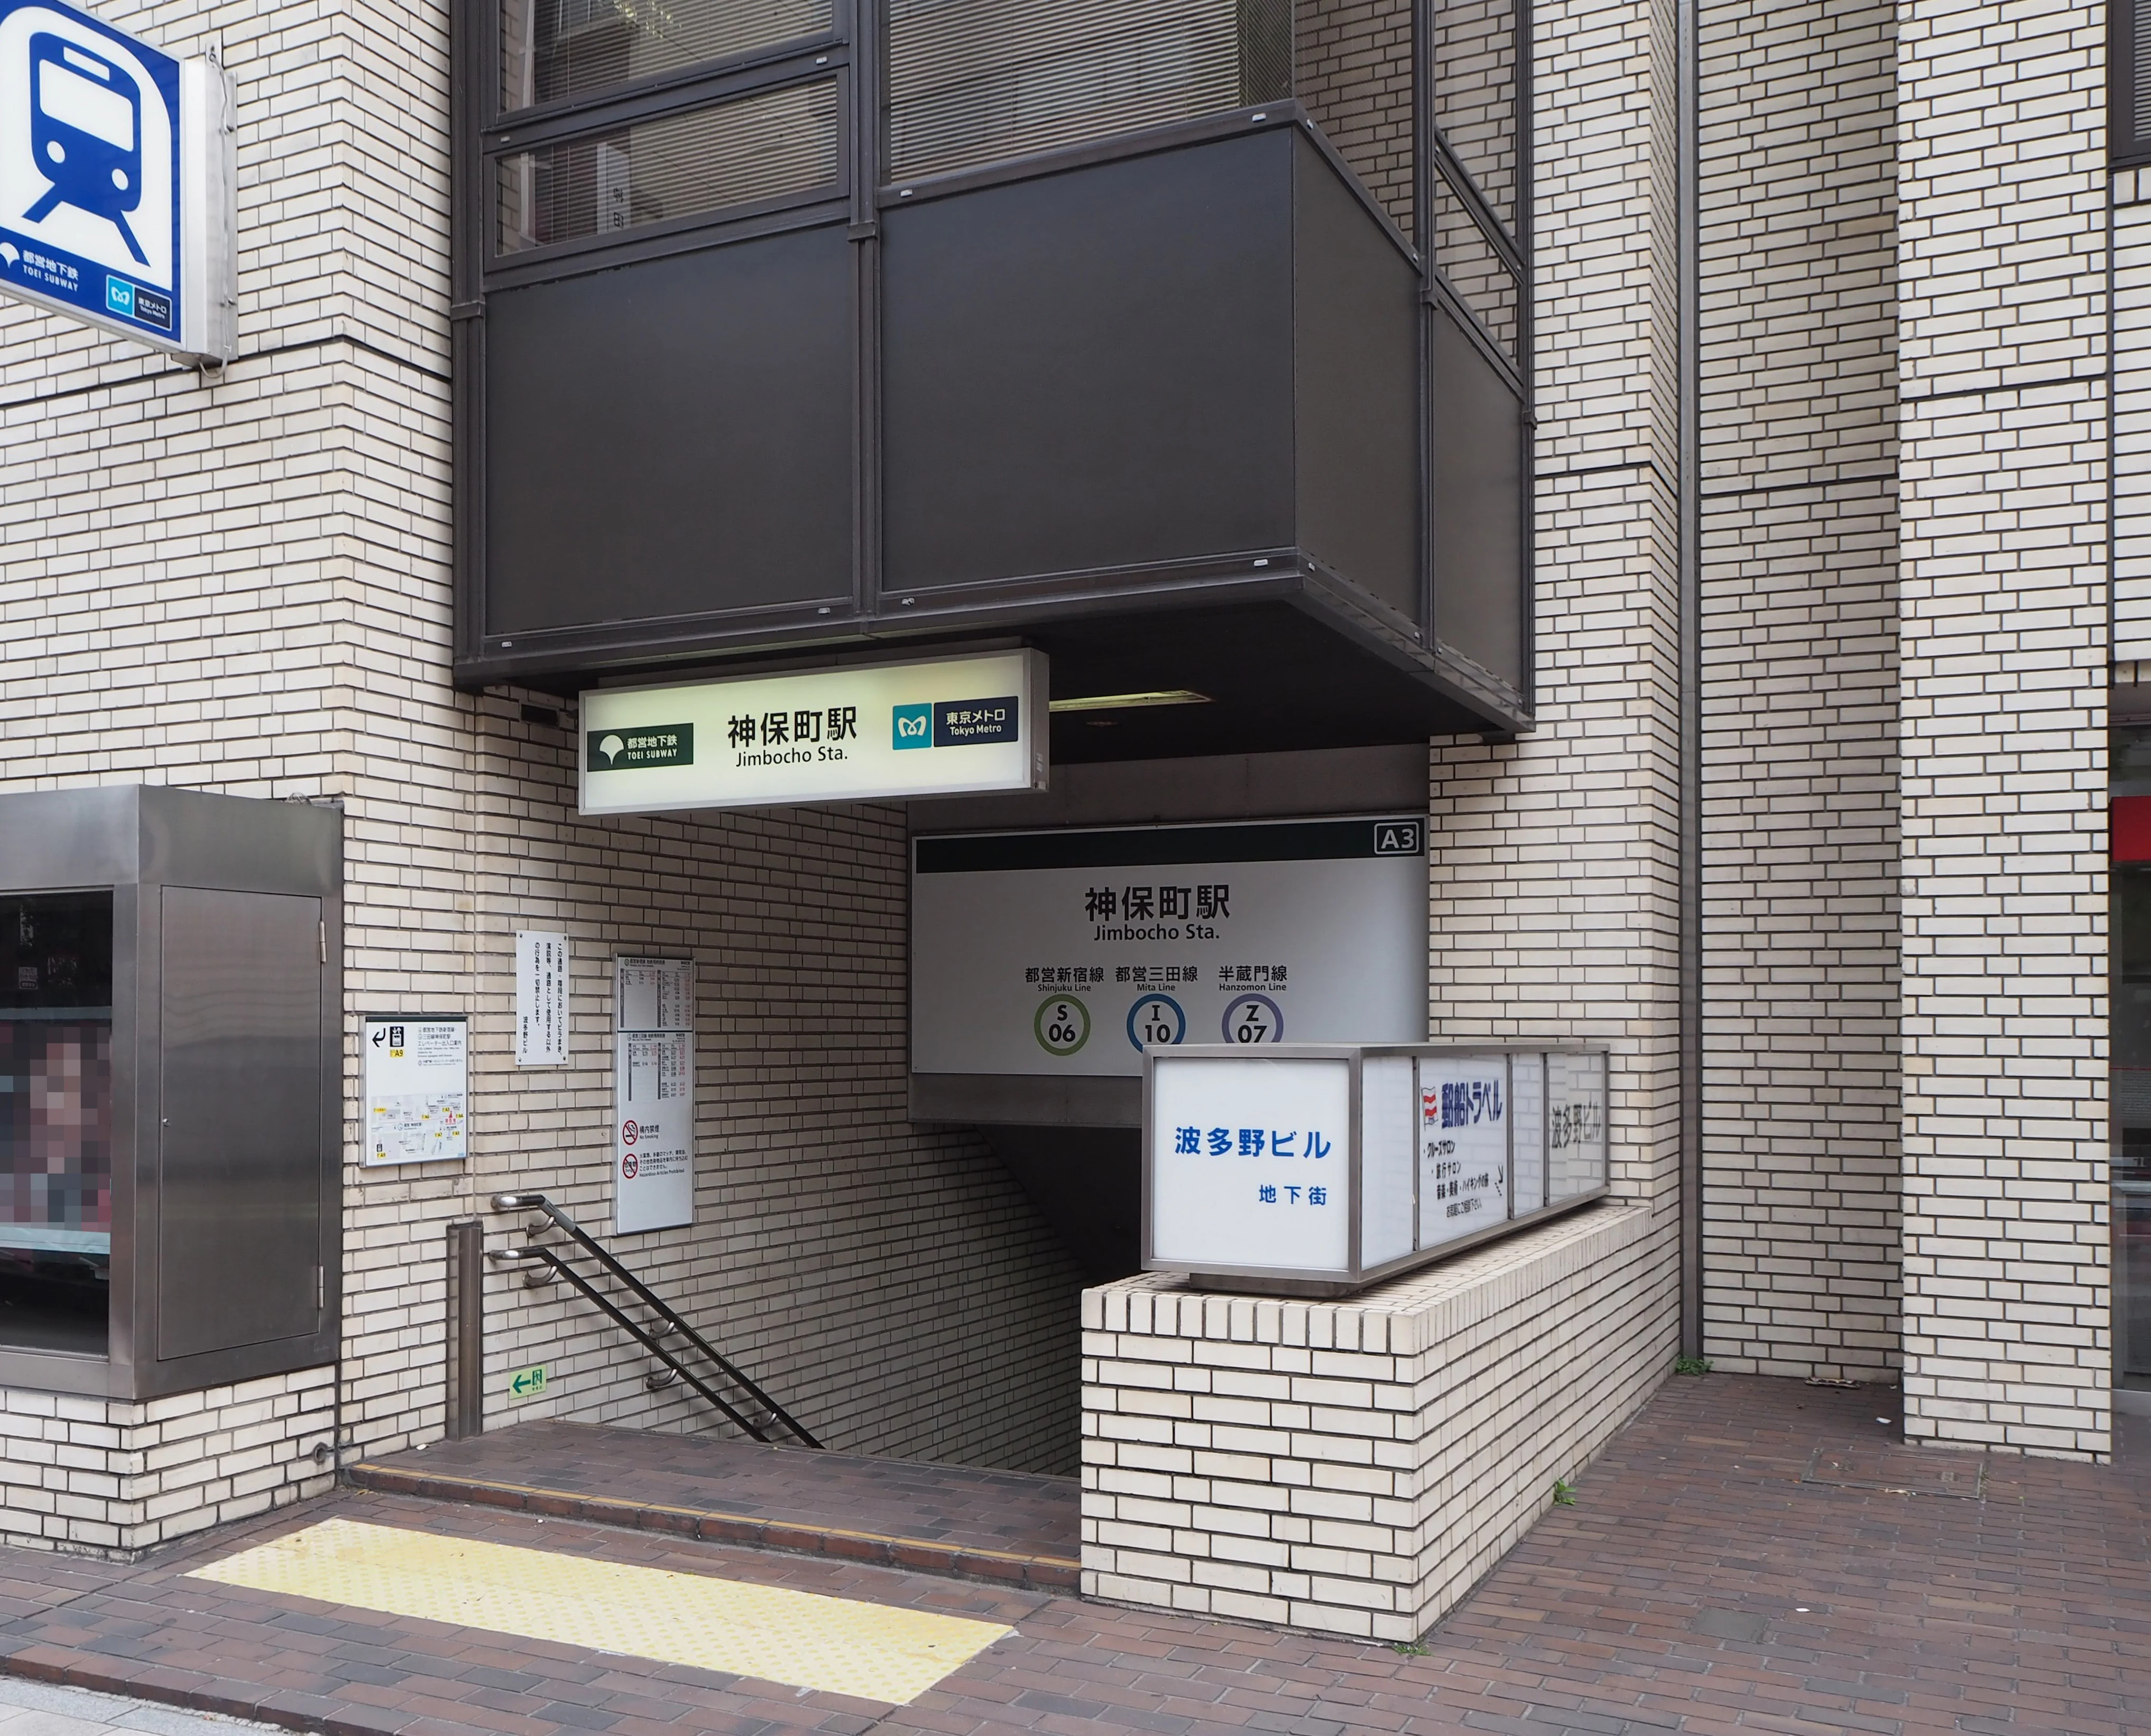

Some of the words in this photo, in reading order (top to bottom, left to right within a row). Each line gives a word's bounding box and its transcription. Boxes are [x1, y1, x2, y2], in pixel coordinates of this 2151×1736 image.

[23, 250, 78, 281] 都営地下鉄
[23, 264, 41, 279] TOEI
[44, 272, 78, 292] SUBWAY
[946, 708, 1005, 725] 東京メトロ
[727, 706, 857, 749] 神保町駅
[949, 726, 974, 737] Tokyo
[976, 724, 1002, 734] Metro
[627, 734, 678, 749] 都営地下鉄
[627, 751, 643, 760] TOEI
[646, 748, 677, 759] SUBWAY
[736, 749, 812, 768] Jimbocho
[818, 745, 848, 762] Sta.
[1381, 828, 1415, 849] A3
[1084, 884, 1230, 922] 神保町駅
[1094, 924, 1179, 941] Jimbocho
[1186, 924, 1220, 940] Sta.
[1025, 966, 1104, 983] 都営新宿線
[1115, 965, 1198, 983] 都営三田線
[1218, 965, 1287, 982] 半蔵門線
[1037, 983, 1073, 994] Shinjuku
[1074, 983, 1092, 992] Line
[1137, 983, 1156, 992] Mita
[1158, 983, 1176, 992] Line
[1219, 983, 1266, 992] Hanzomon
[1268, 983, 1287, 991] Line
[1057, 1005, 1068, 1021] S
[1151, 1004, 1160, 1021] I
[1245, 1004, 1259, 1022] Z
[1048, 1023, 1076, 1043] 06
[1145, 1024, 1170, 1043] 10
[1238, 1024, 1268, 1044] 07
[1442, 1079, 1502, 1129] 郵船トラベル
[640, 1125, 659, 1133] 構内禁煙
[1175, 1126, 1332, 1159] 波多野ビル
[1259, 1184, 1327, 1206] 地下街
